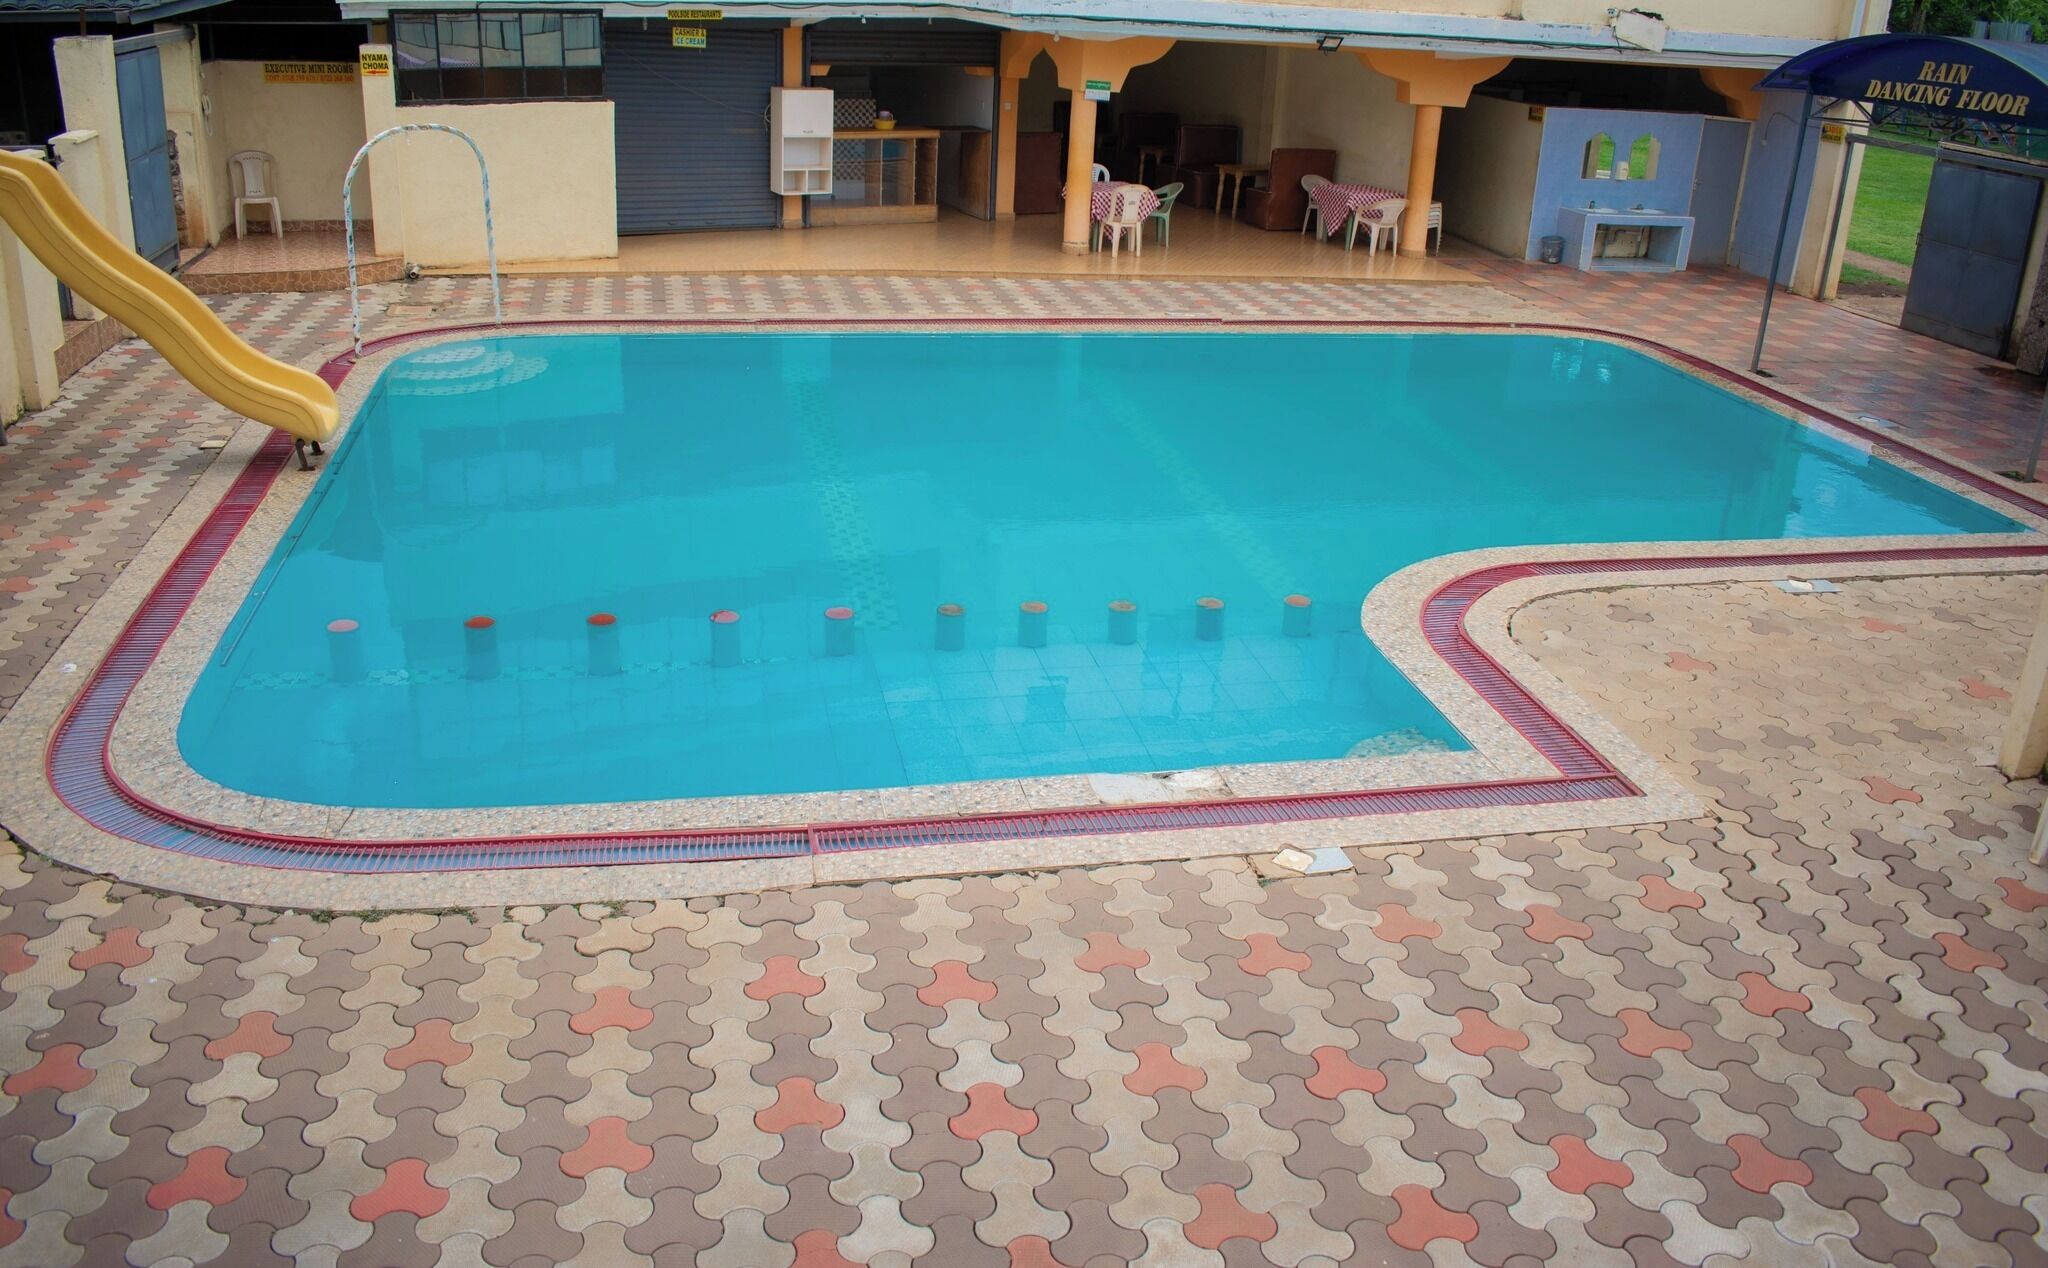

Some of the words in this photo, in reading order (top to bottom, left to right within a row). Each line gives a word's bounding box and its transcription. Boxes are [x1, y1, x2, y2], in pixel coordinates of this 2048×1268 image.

[668, 10, 689, 18] POOLSIDE
[674, 28, 699, 37] CASHIER
[686, 37, 705, 45] CREAM
[264, 64, 305, 73] EXECUTIVE
[308, 64, 325, 74] MINI
[327, 64, 354, 74] ROOMS
[362, 62, 389, 70] CHOMA
[1917, 60, 1974, 85] RAIN
[1864, 79, 1952, 107] DANCING
[1955, 88, 2030, 117] FLOOR
